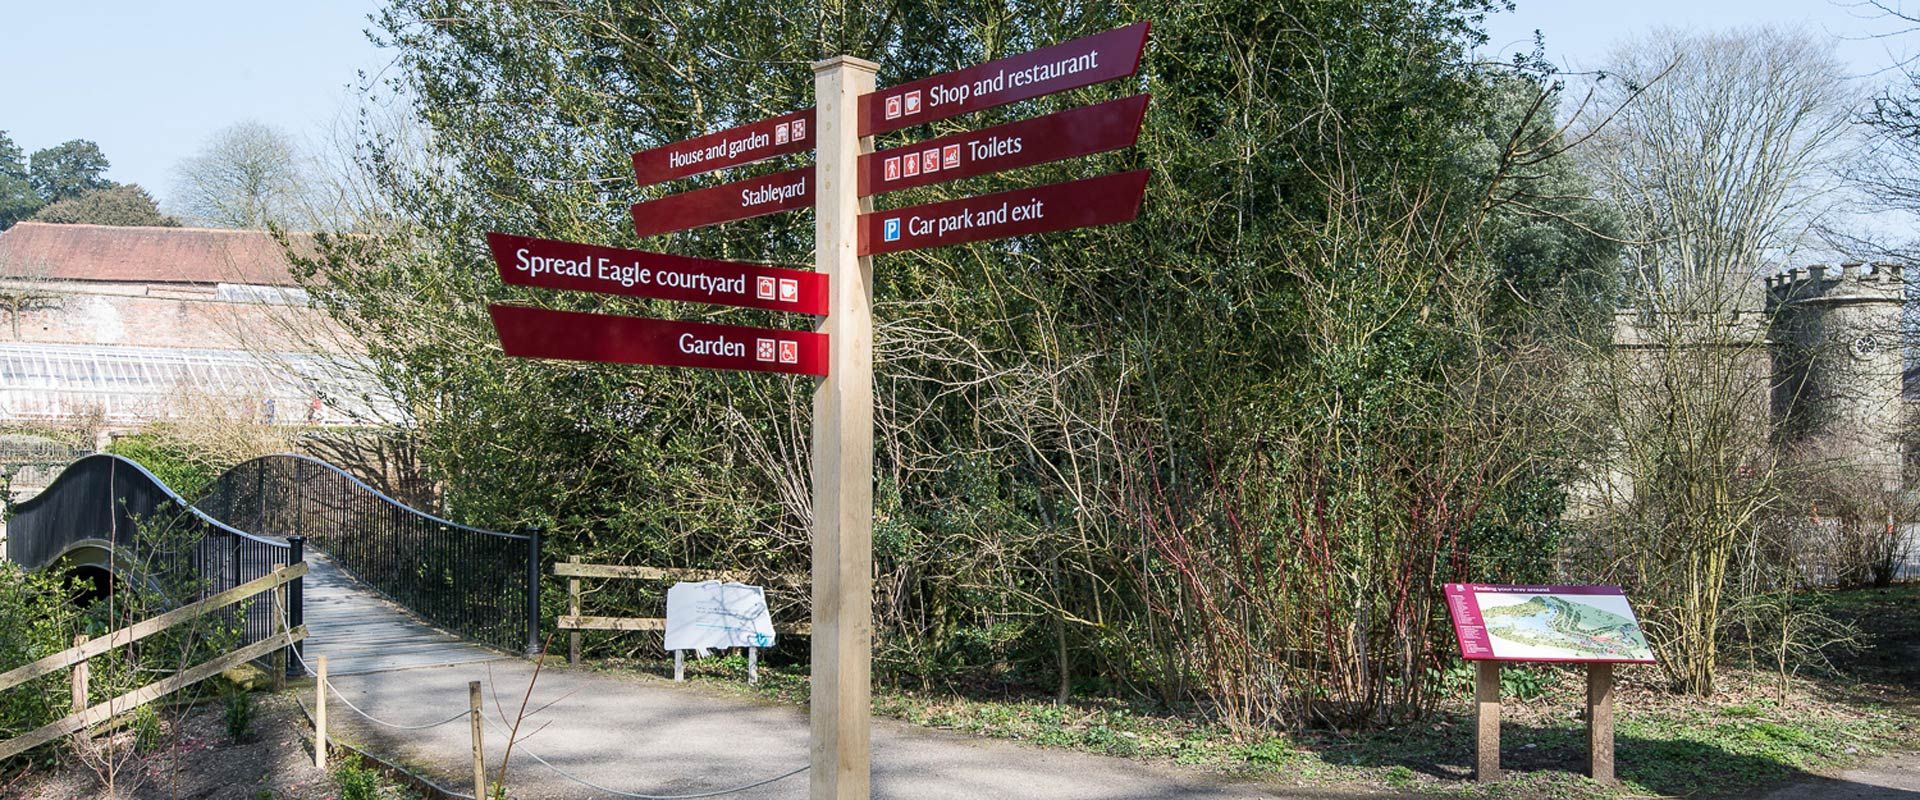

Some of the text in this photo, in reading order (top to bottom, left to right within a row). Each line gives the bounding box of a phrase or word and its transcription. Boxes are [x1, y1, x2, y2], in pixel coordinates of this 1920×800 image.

[929, 50, 1099, 107] Shop and restaurant
[669, 132, 769, 168] House and garden
[968, 136, 1023, 161] Toilets
[741, 177, 806, 207] Stableyard
[887, 222, 897, 239] P
[908, 197, 1044, 237] Car park and exit
[516, 248, 746, 295] Spread Eagle courtyard
[678, 333, 745, 357] Garden
[1473, 585, 1497, 593] Finding
